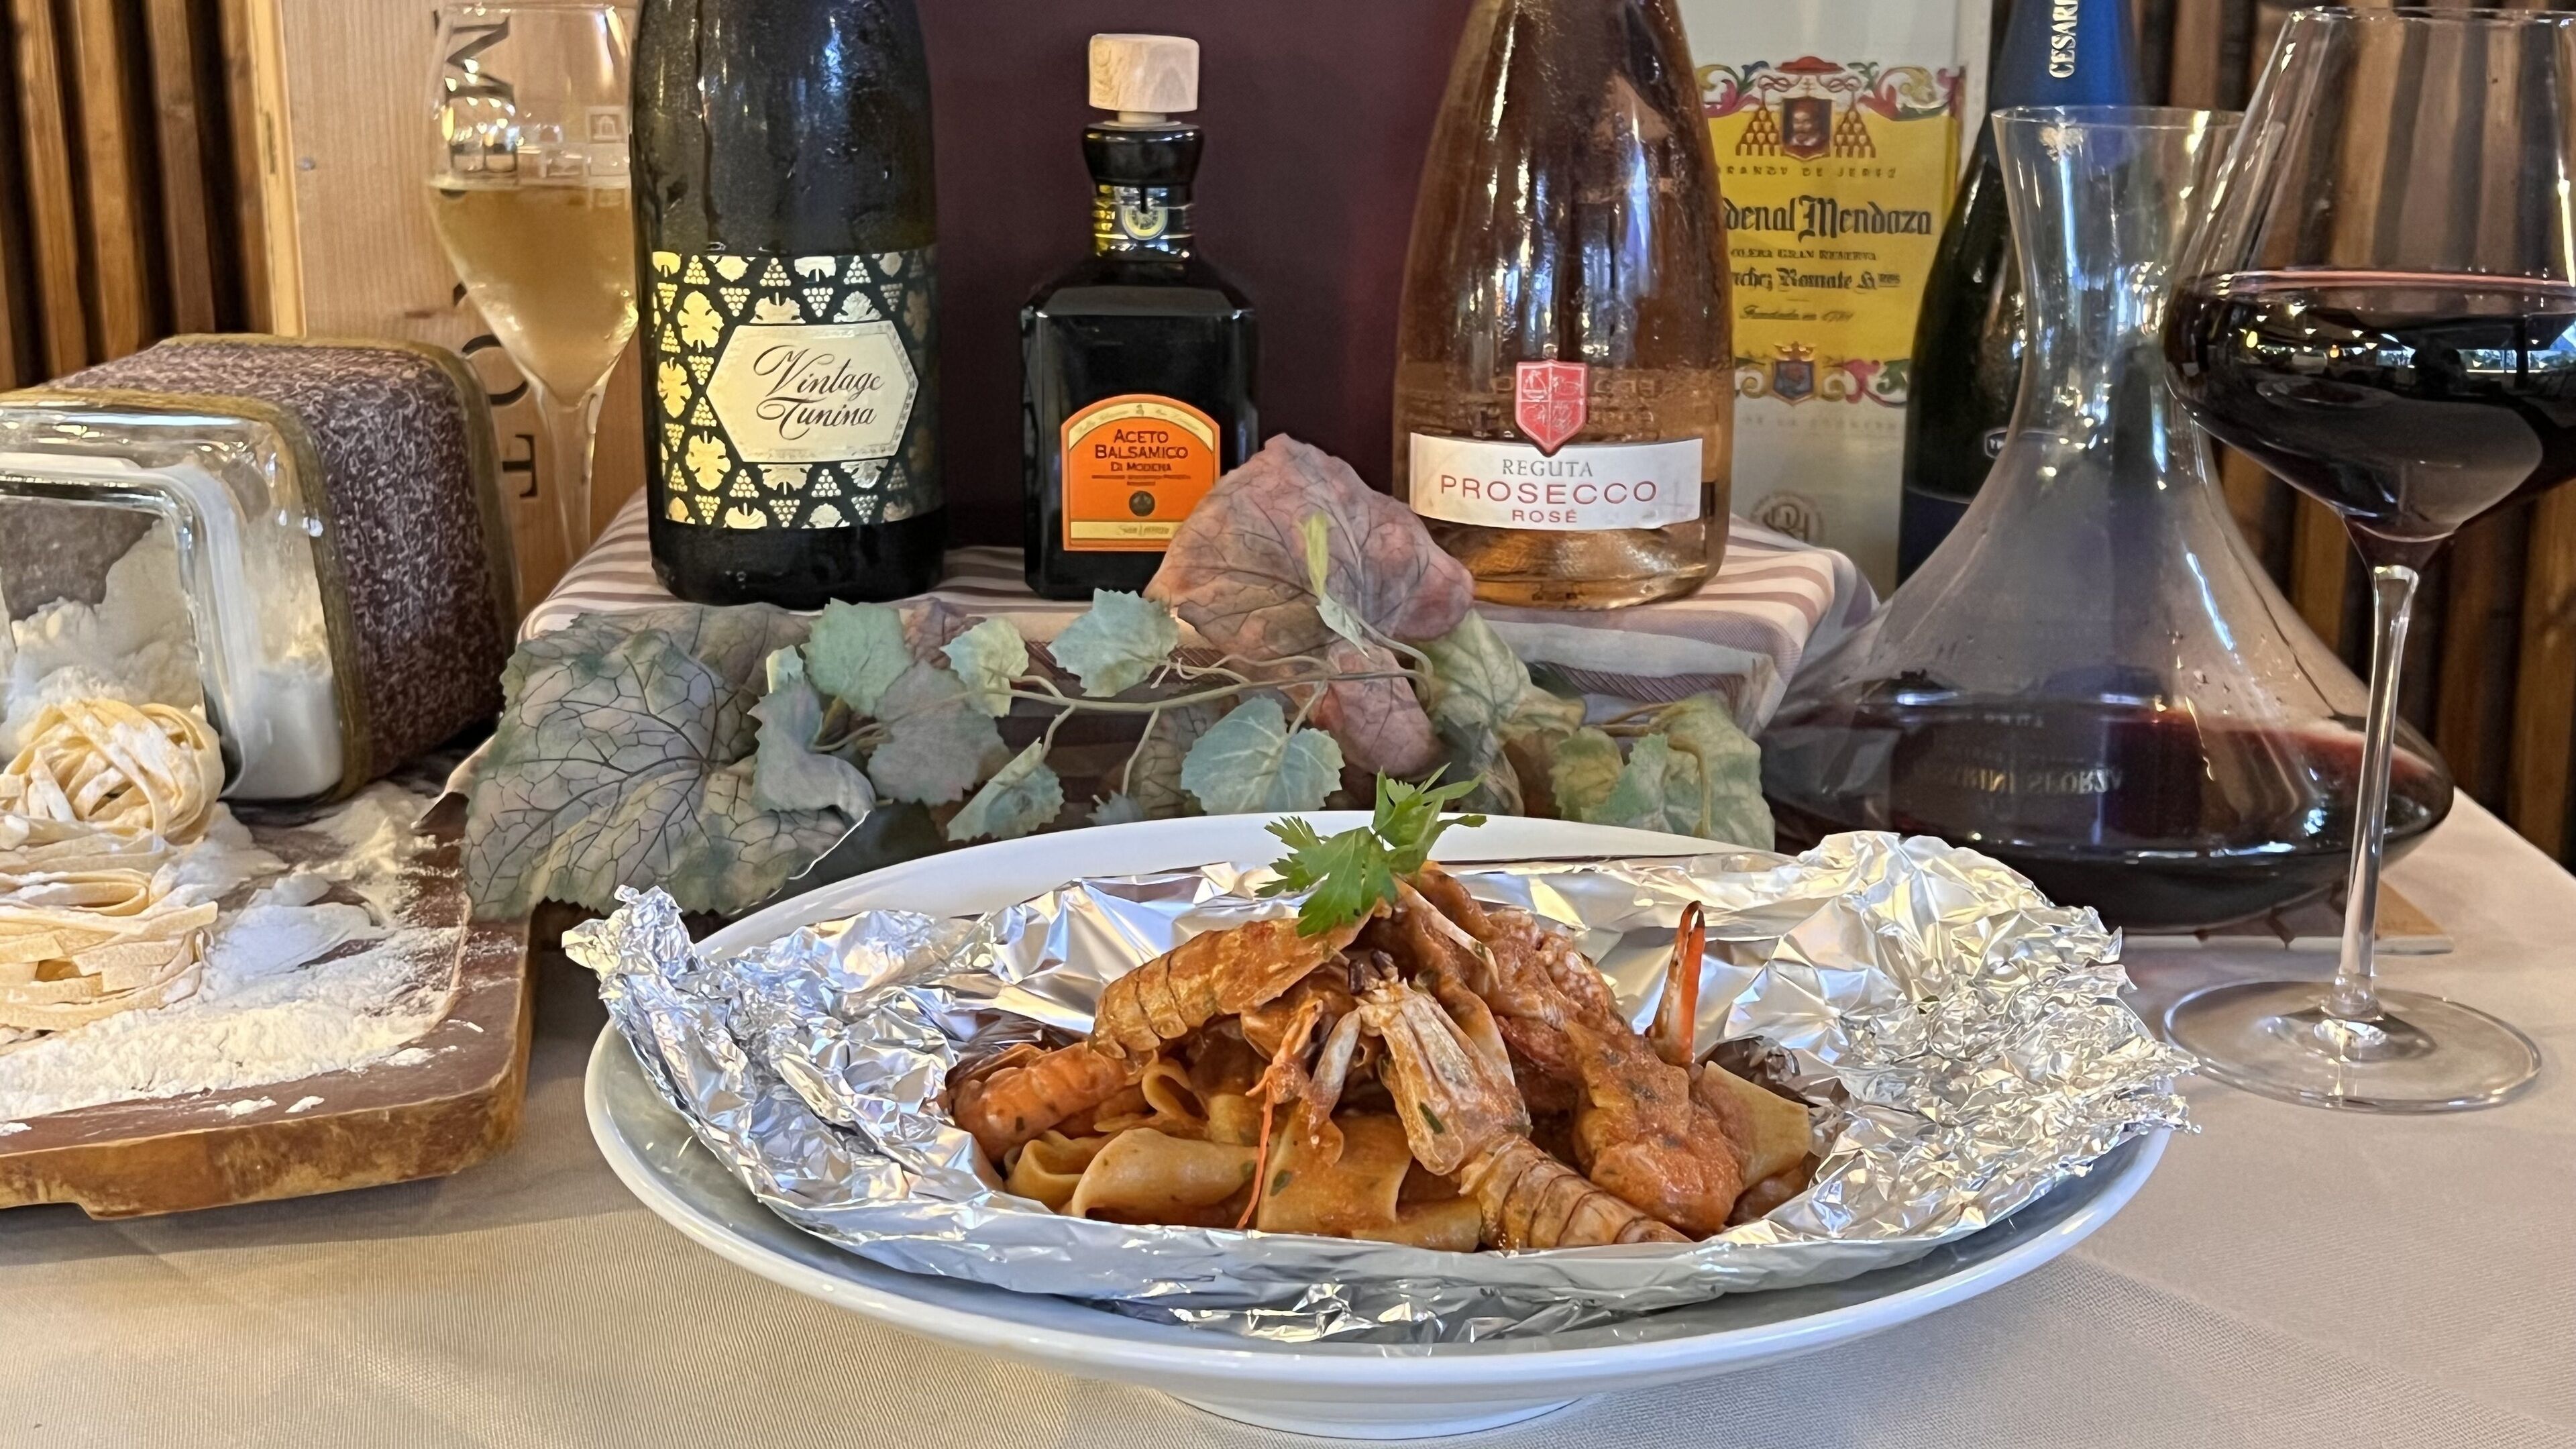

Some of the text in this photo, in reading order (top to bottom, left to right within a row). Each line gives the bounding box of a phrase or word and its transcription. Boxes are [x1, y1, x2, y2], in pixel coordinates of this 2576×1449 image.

[1718, 165, 1788, 176] RANDY
[1723, 195, 1932, 243] denal Mendoza
[754, 345, 885, 400] Vintage
[756, 396, 877, 440] Tunina
[1113, 429, 1169, 443] ACETO
[1095, 444, 1189, 459] BALSAMICO
[1503, 458, 1594, 477] REGUTA
[1440, 474, 1658, 505] PROSECCO
[1511, 508, 1578, 523] ROSÉ
